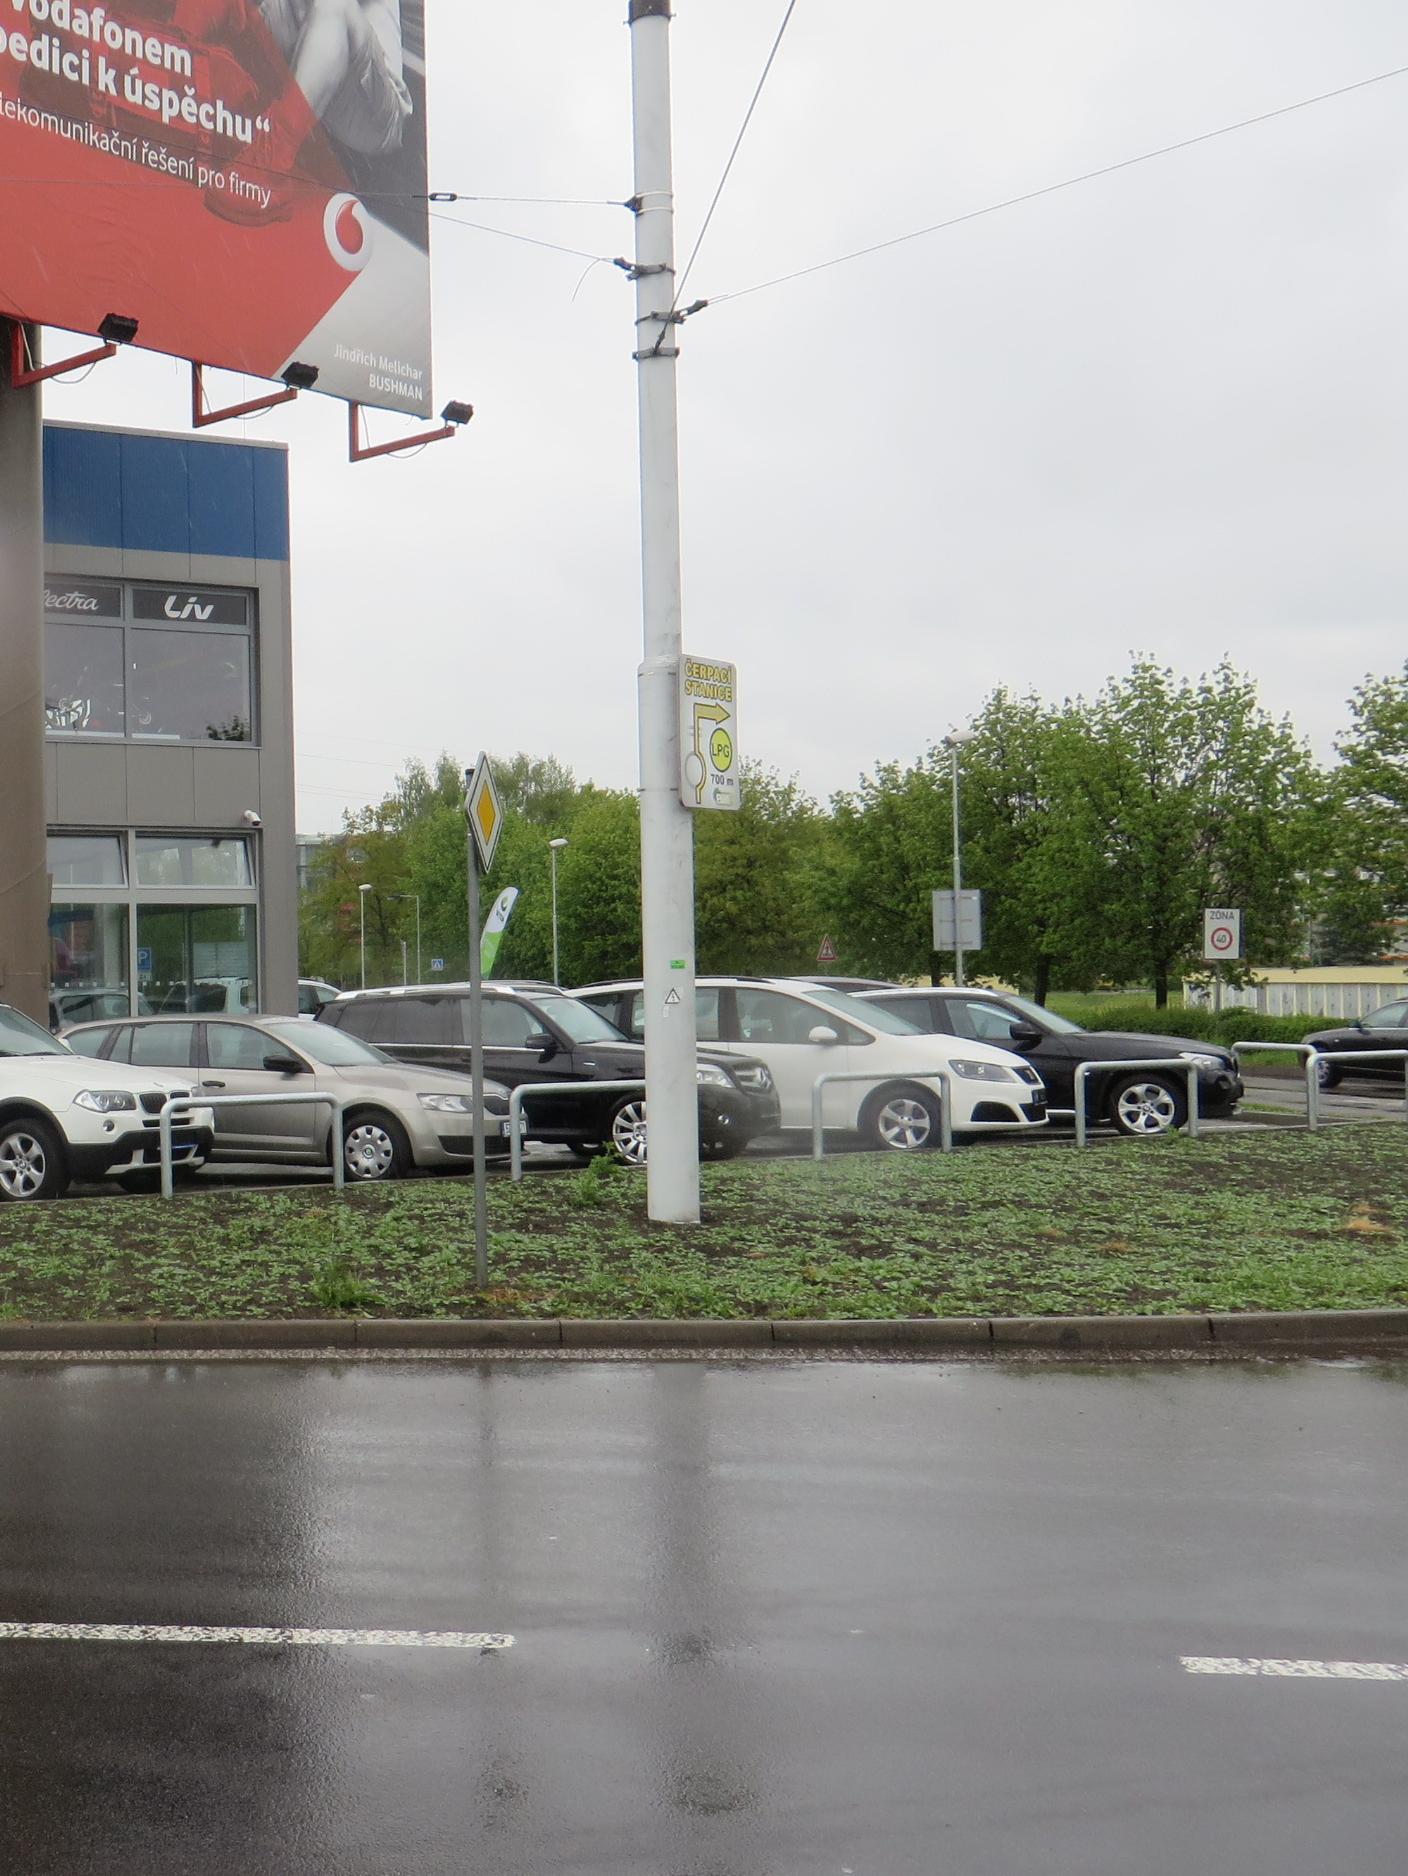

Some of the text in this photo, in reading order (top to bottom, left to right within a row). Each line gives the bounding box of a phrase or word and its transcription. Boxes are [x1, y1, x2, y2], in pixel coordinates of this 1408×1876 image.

[98, 56, 118, 96] k
[141, 140, 195, 180] řešení
[197, 165, 225, 189] pro
[228, 171, 272, 208] firmy
[369, 373, 423, 401] BUSHMAN
[164, 594, 215, 620] Liv
[684, 658, 733, 684] ČERPACÍ
[684, 679, 733, 702] STANICE
[711, 743, 730, 759] LPG
[710, 774, 734, 786] 700 m
